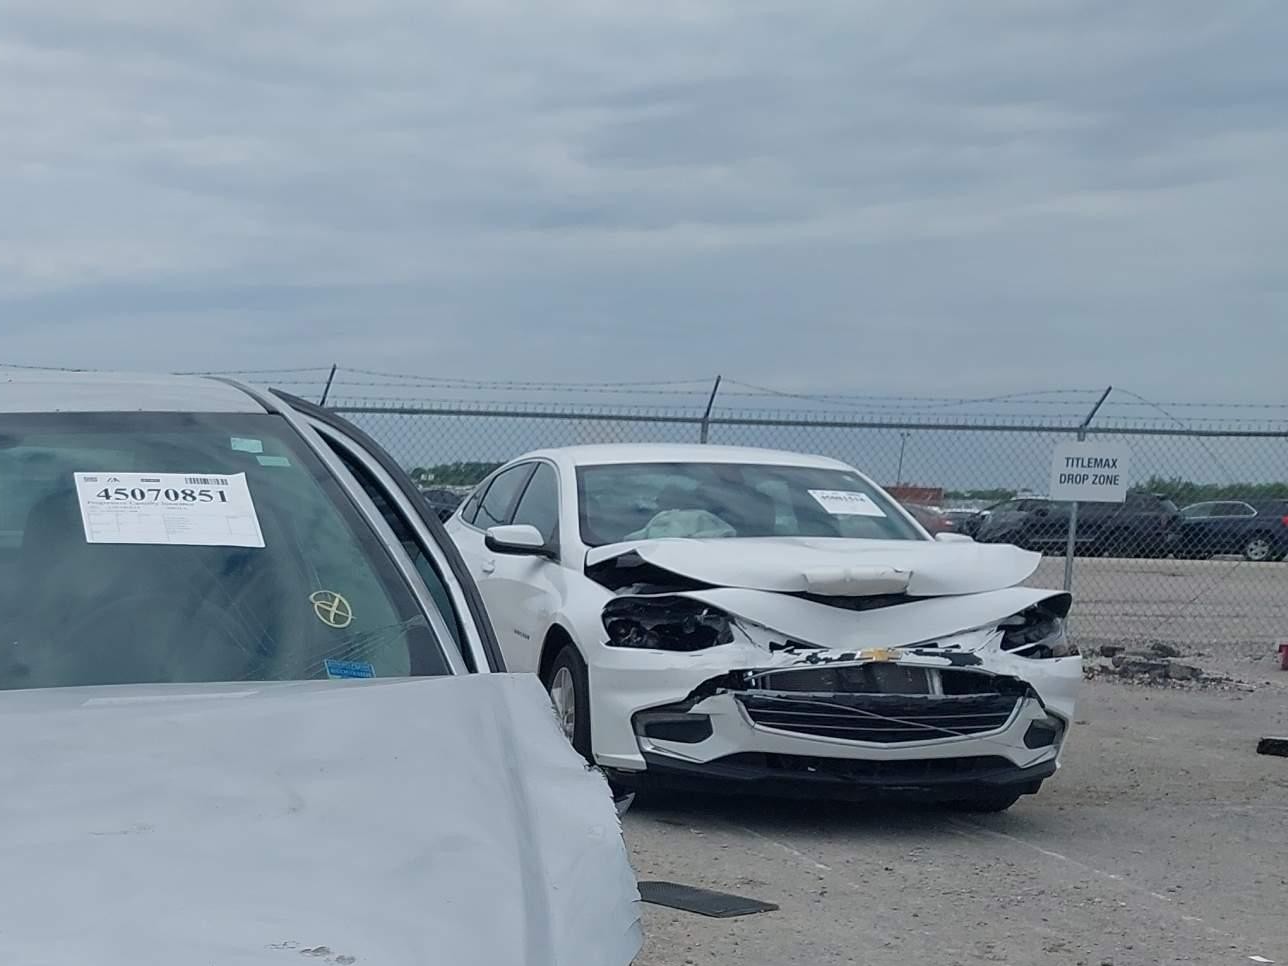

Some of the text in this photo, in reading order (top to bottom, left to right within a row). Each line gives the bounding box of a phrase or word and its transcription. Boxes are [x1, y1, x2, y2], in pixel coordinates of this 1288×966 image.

[1064, 456, 1118, 469] TITLEMAX
[1059, 473, 1120, 486] DROP ZONE
[96, 487, 229, 503] 45070851
